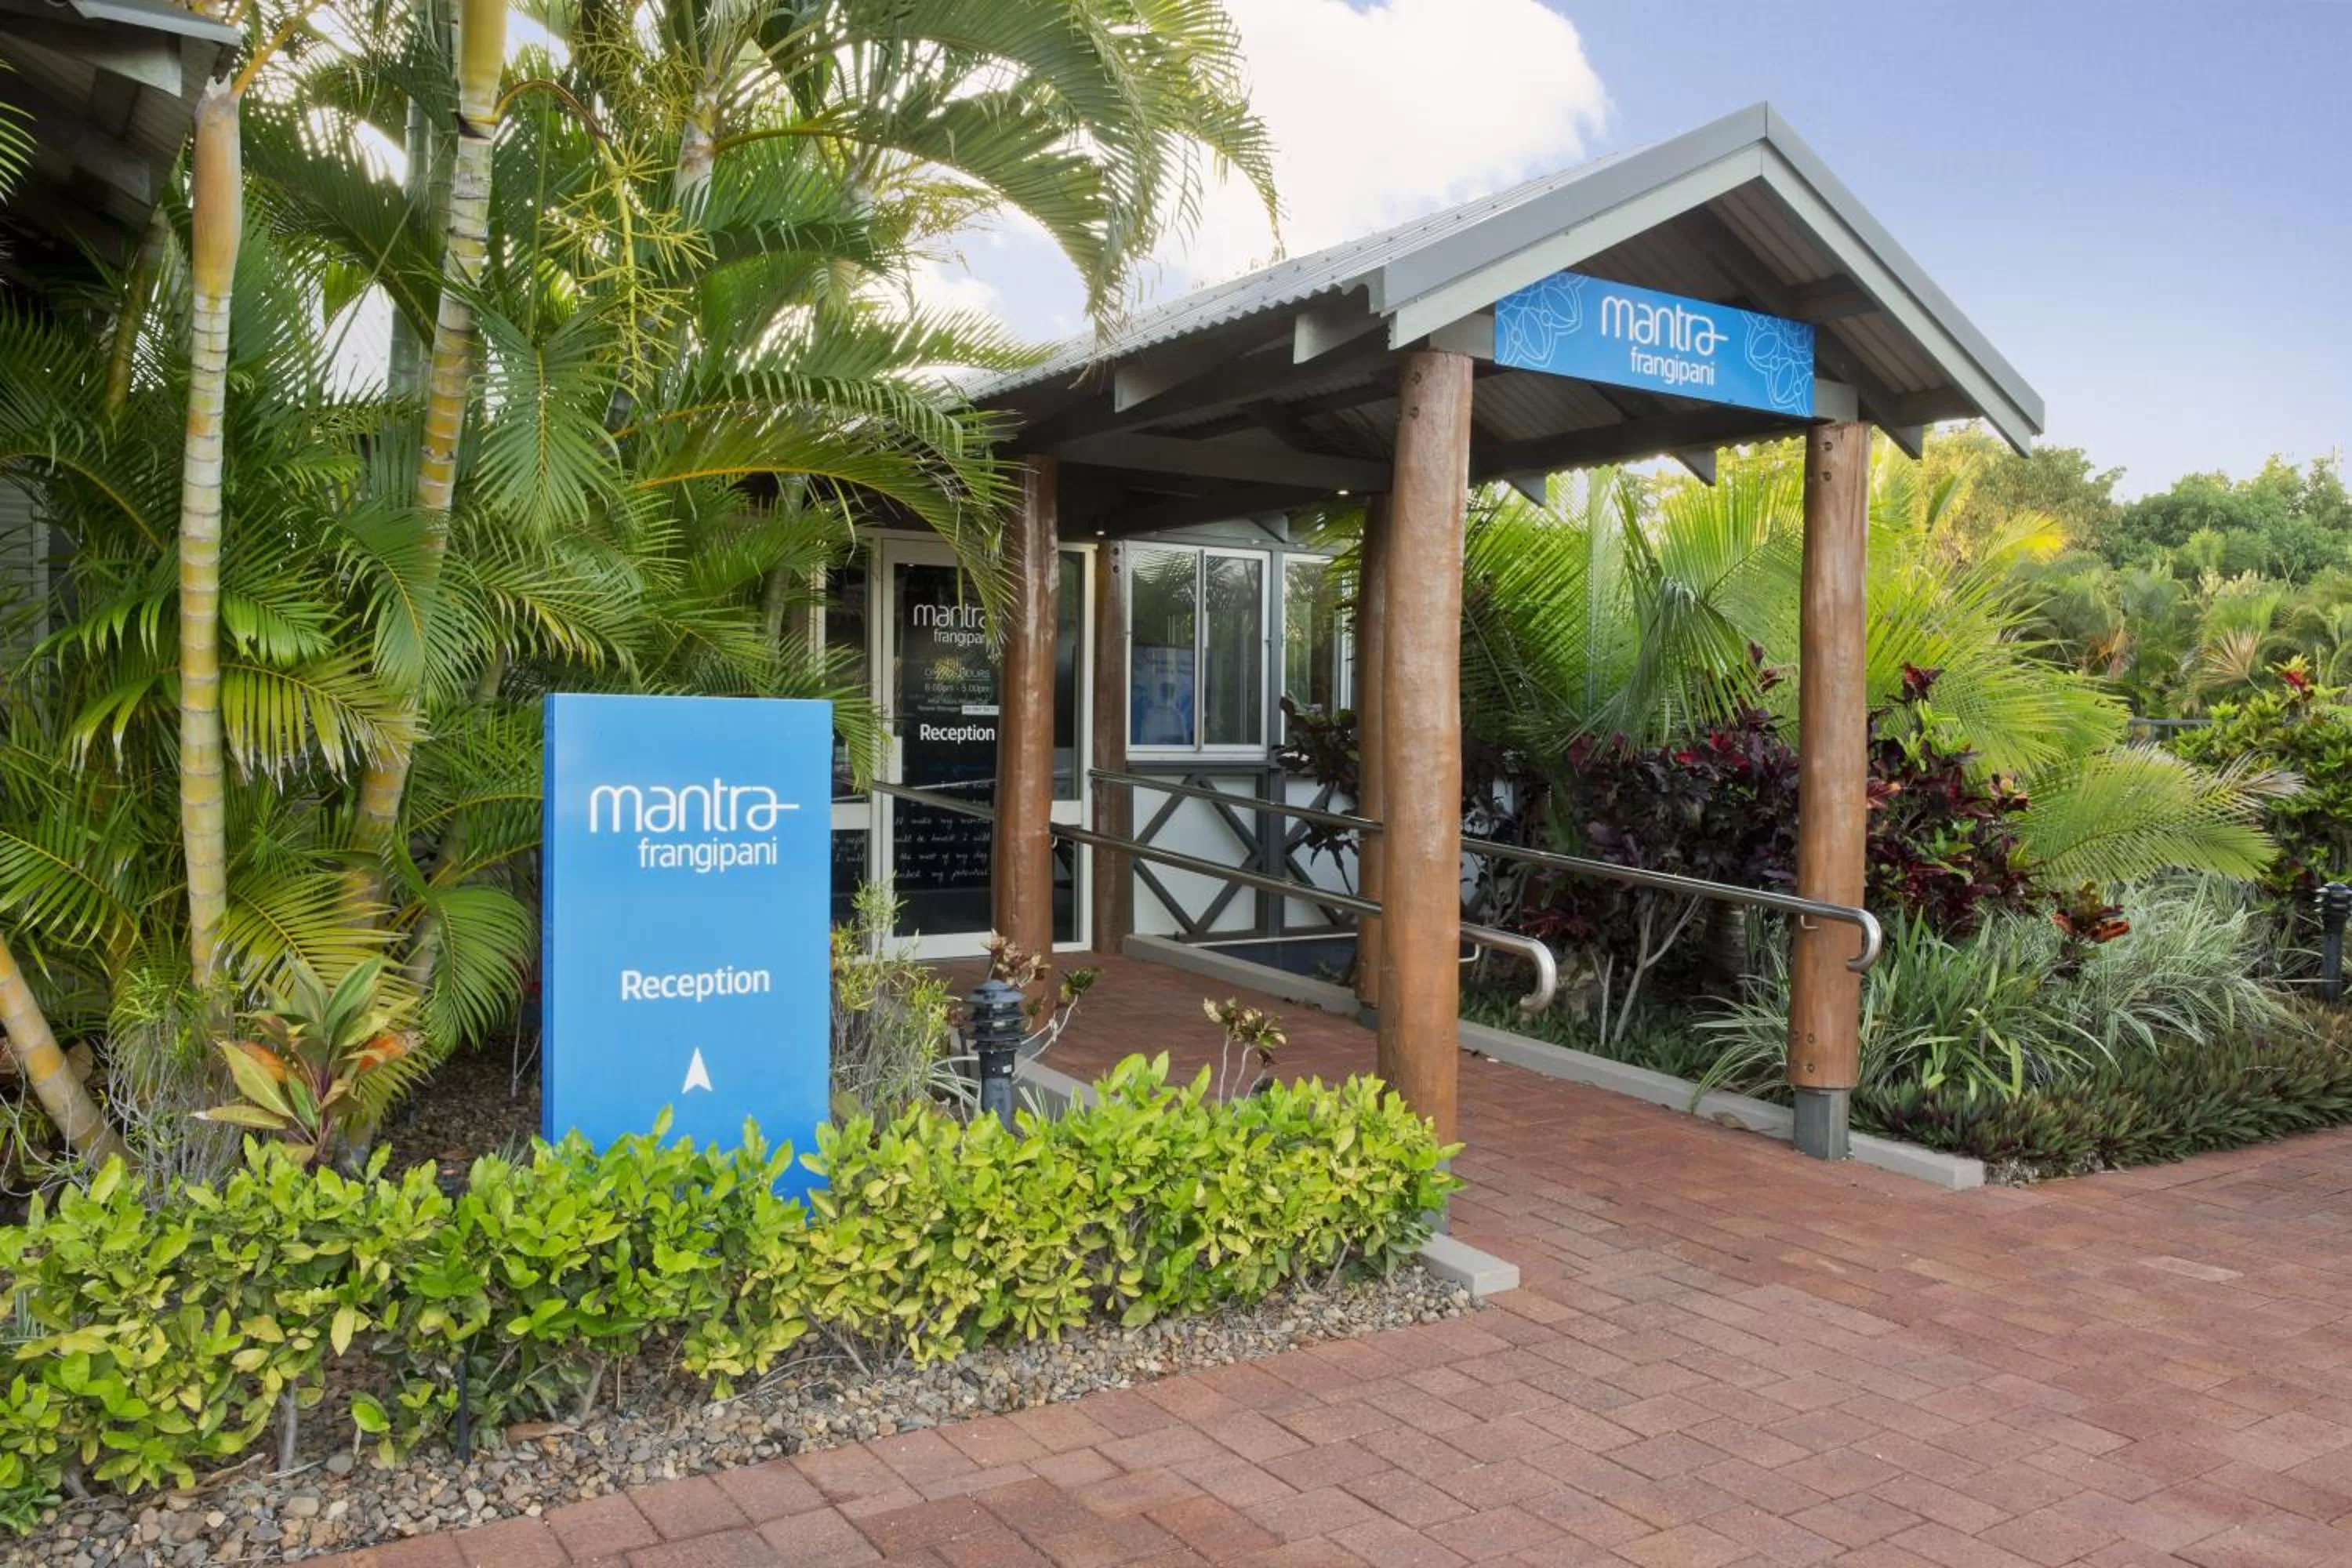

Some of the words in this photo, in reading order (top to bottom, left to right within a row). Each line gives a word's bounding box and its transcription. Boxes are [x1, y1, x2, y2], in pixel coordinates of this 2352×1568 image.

[1601, 296, 1730, 356] mantra
[1631, 346, 1716, 386] frangipani
[934, 629, 985, 647] frangipa
[920, 723, 995, 744] Reception
[590, 778, 800, 833] mantra
[637, 836, 778, 873] frangipani
[621, 966, 770, 1003] Reception
